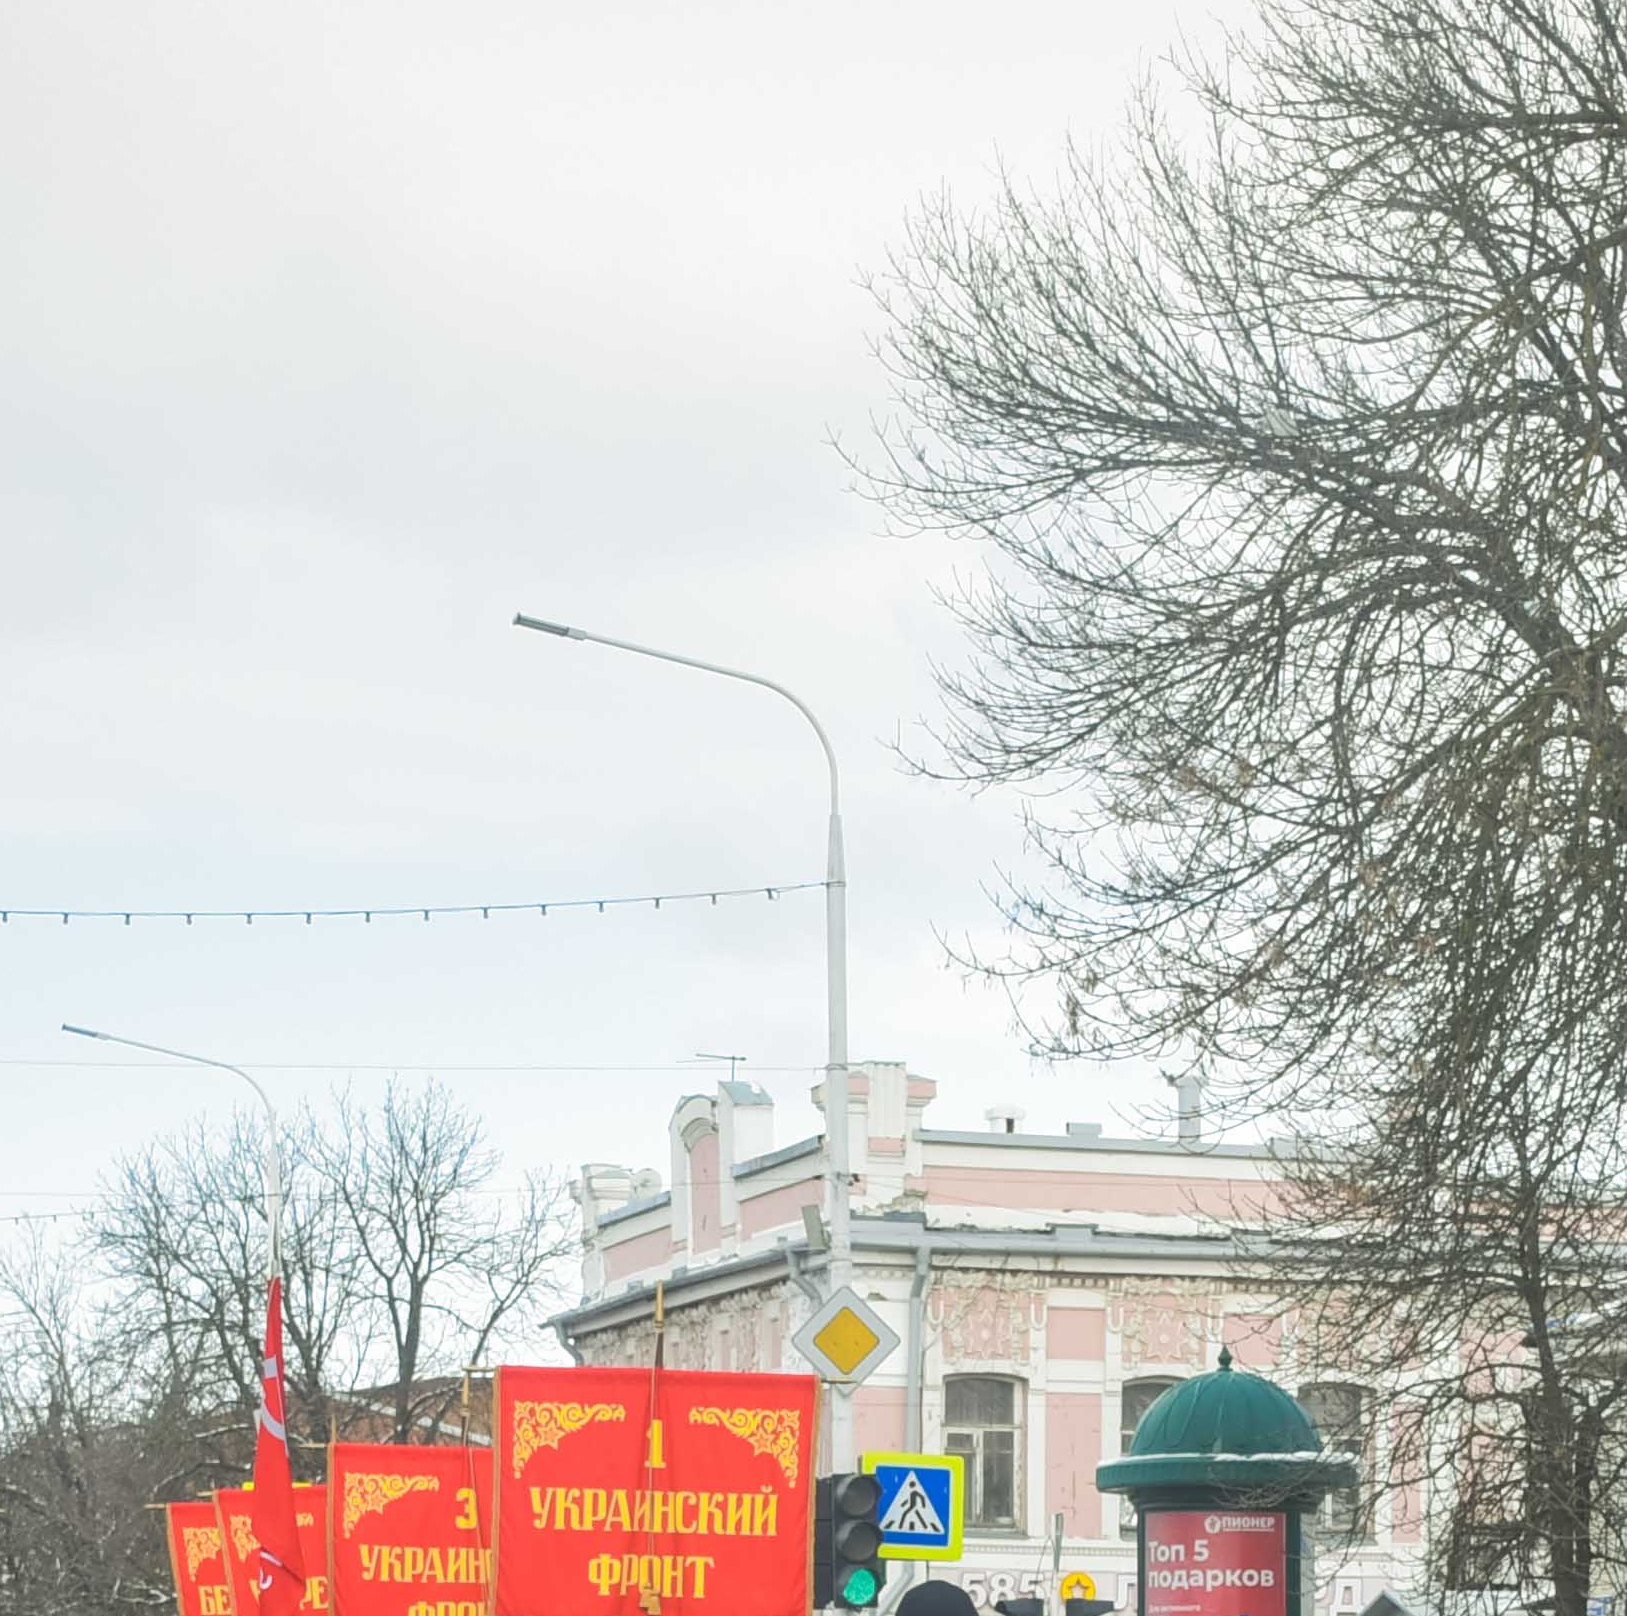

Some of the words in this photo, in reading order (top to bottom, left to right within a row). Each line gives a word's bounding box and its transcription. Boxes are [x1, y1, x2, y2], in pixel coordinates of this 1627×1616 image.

[645, 1419, 666, 1468] 1
[529, 1485, 778, 1536] УКРАИНСКИЙ
[1222, 1516, 1275, 1529] ПИОНЕР
[1148, 1541, 1185, 1563] Топ
[1193, 1539, 1210, 1562] 5
[588, 1554, 715, 1599] ФРОНТ
[1148, 1568, 1275, 1592] подарков
